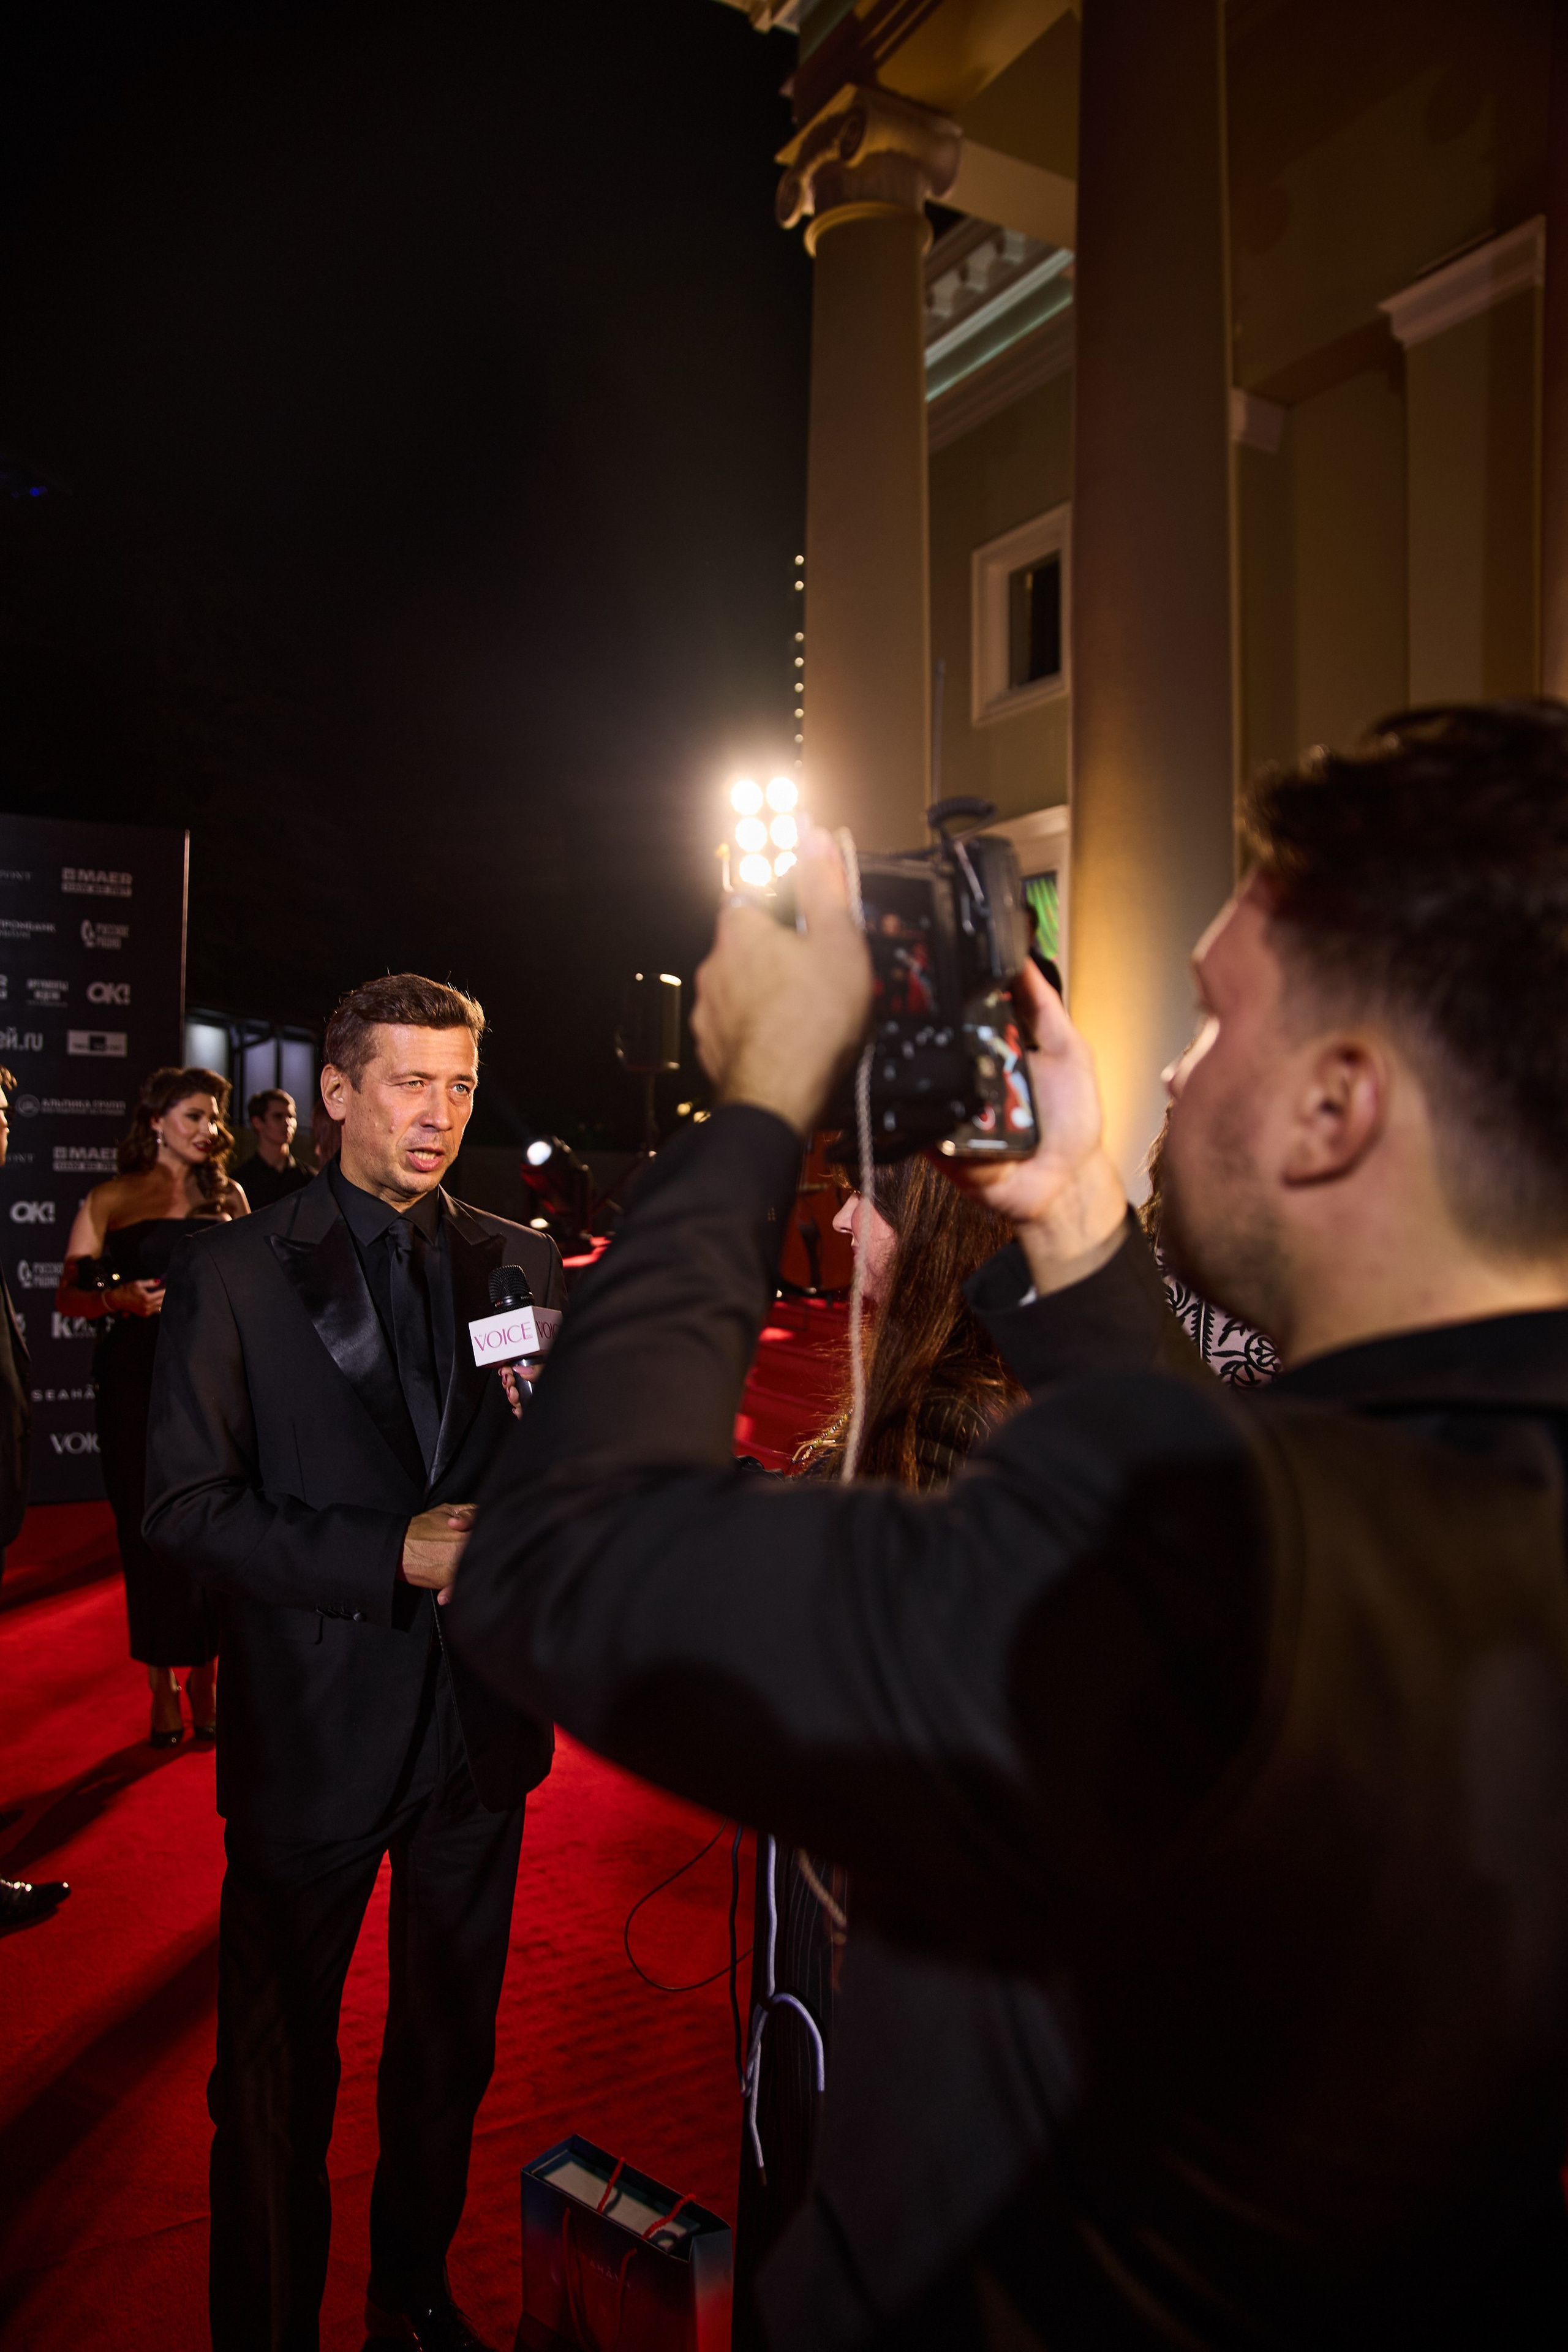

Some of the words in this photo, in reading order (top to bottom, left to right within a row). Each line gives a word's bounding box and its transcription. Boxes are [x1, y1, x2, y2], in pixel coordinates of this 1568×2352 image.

[86, 981, 131, 1006] OK!
[9, 1200, 56, 1224] OK!
[474, 1322, 531, 1351] VOICE
